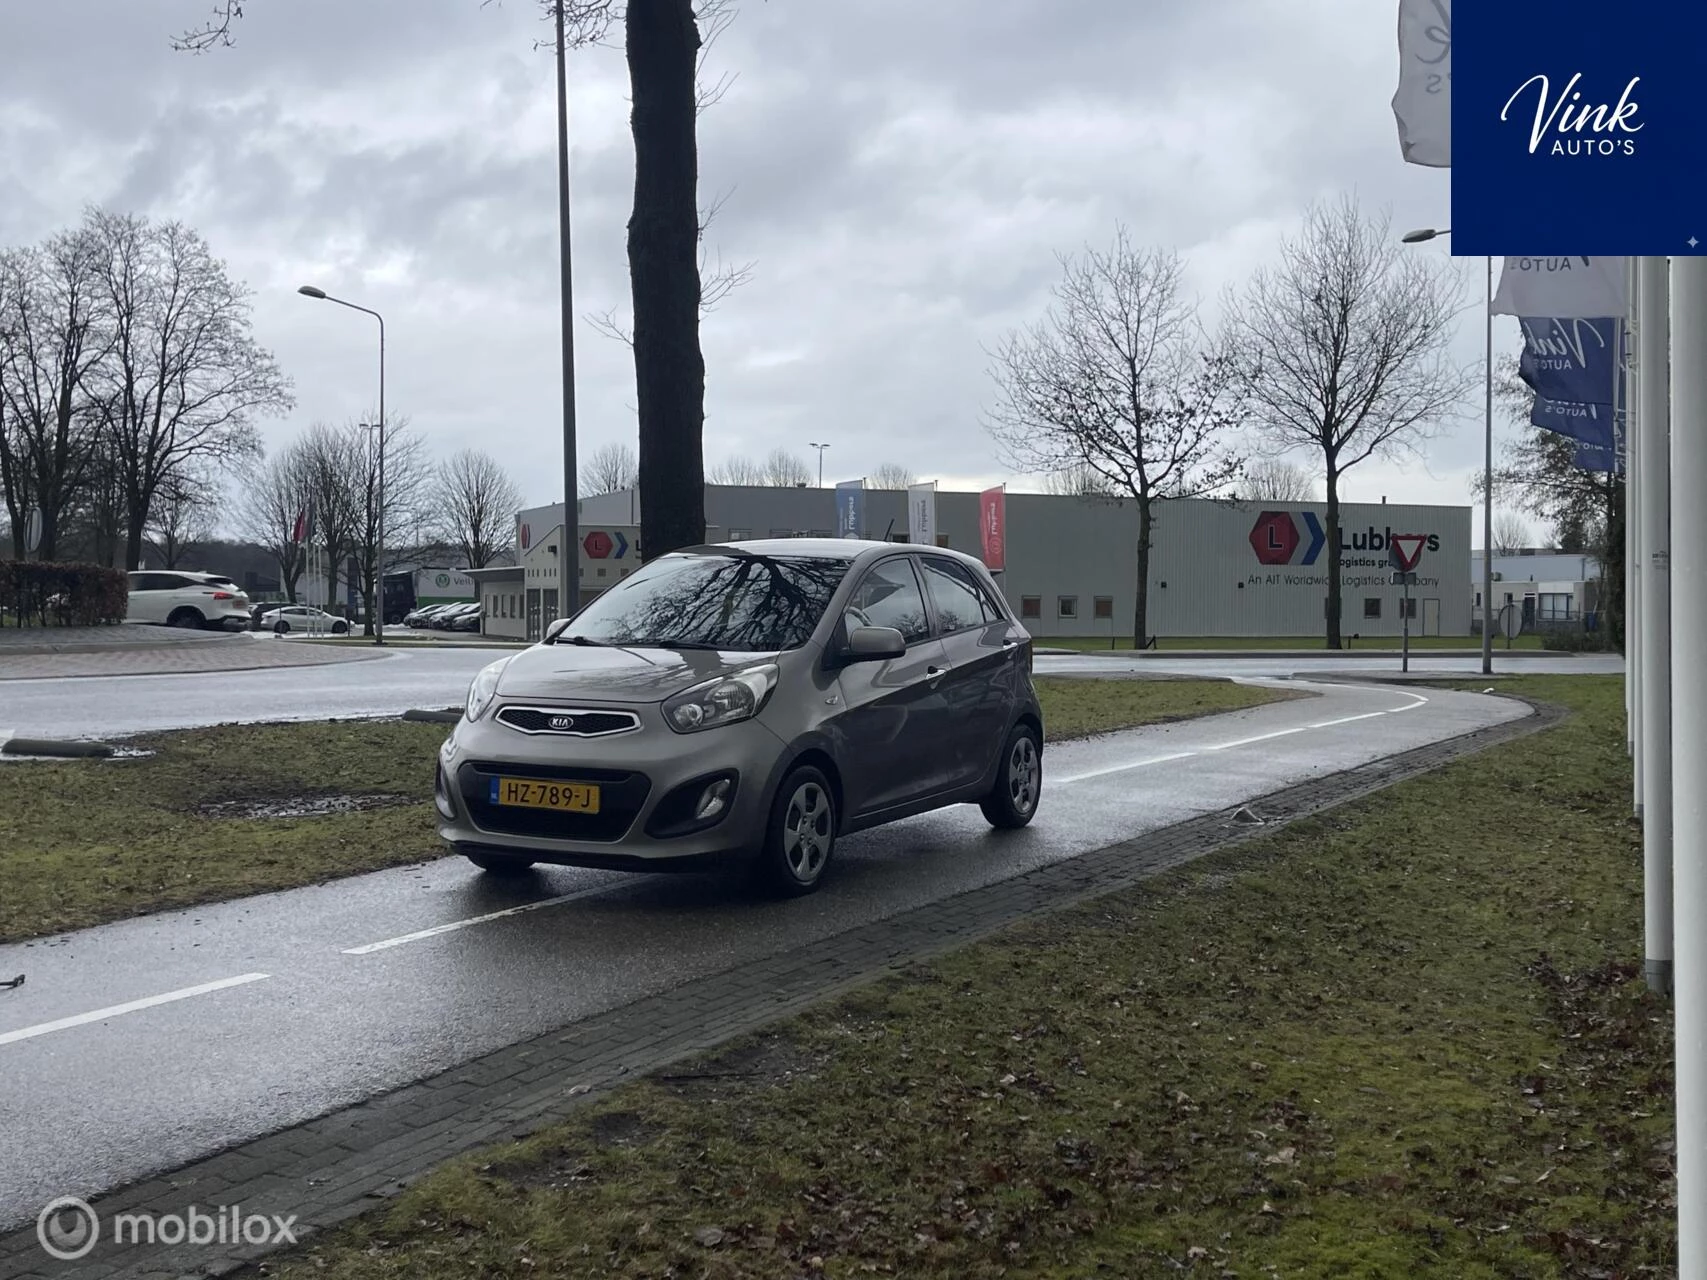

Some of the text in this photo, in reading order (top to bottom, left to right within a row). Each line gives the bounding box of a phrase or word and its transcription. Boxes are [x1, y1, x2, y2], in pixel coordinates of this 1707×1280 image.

[1268, 525, 1284, 549] L
[1339, 556, 1376, 568] ogistics
[1248, 574, 1262, 585] An
[1266, 574, 1281, 585] AIT
[1342, 575, 1385, 588] Logistics
[551, 717, 570, 727] KIA
[507, 782, 591, 808] HZ-789-J
